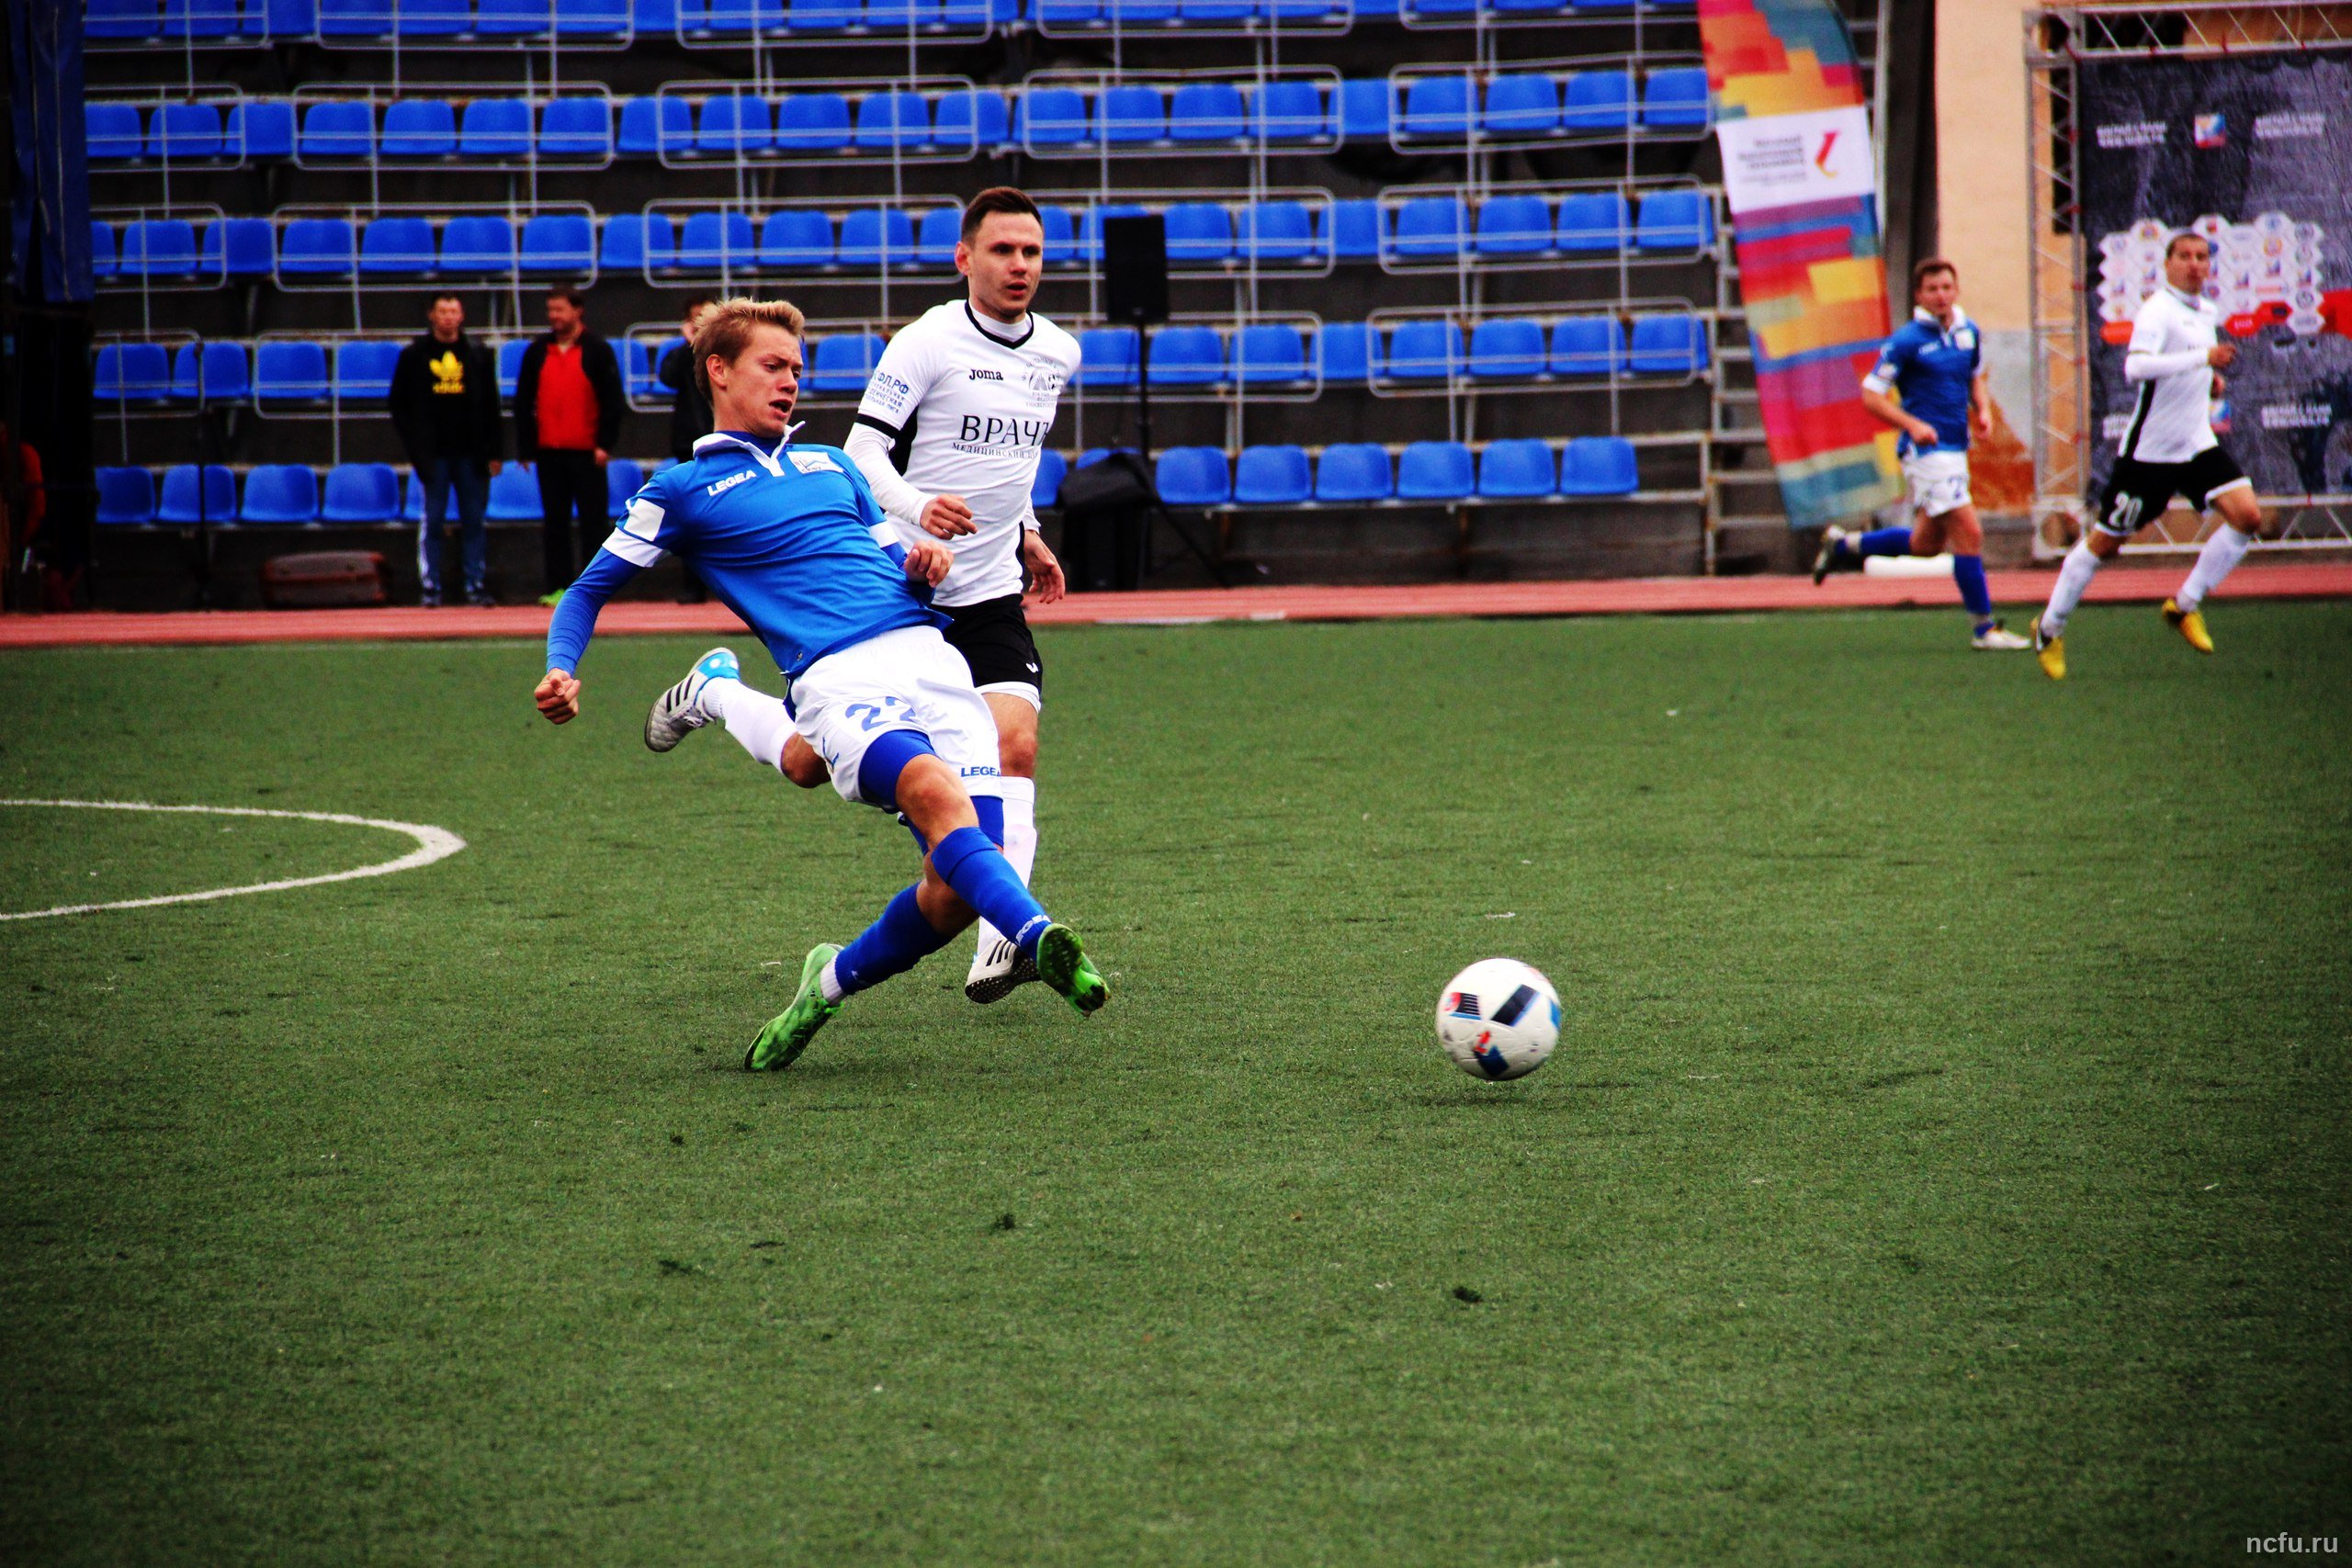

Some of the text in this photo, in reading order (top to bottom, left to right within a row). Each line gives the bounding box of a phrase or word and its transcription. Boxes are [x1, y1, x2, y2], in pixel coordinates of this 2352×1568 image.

[968, 368, 1004, 381] Joma
[707, 469, 757, 497] LEGEA
[2108, 491, 2143, 528] 20
